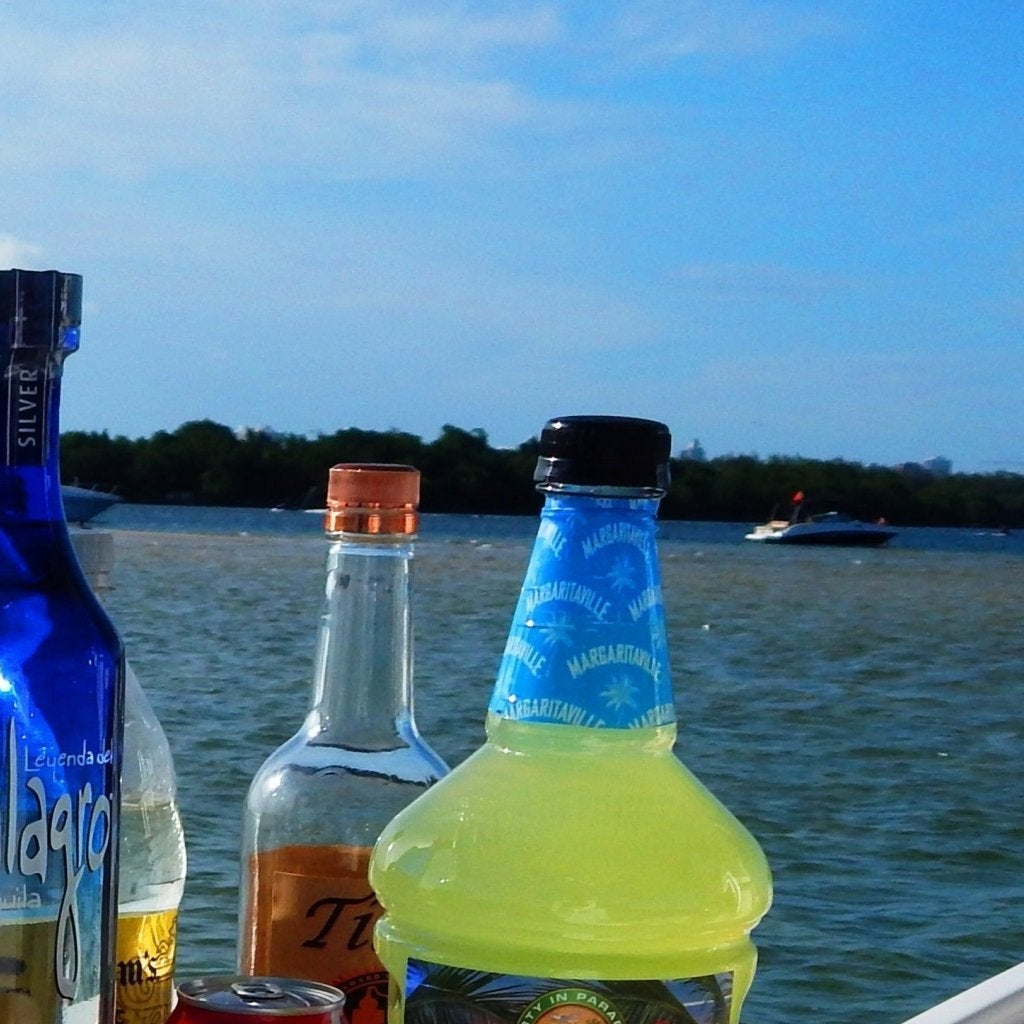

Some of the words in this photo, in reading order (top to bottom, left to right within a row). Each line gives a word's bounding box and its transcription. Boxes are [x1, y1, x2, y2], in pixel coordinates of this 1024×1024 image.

[18, 368, 38, 447] SILVER
[24, 739, 94, 782] Leyenda
[549, 991, 568, 1004] IN
